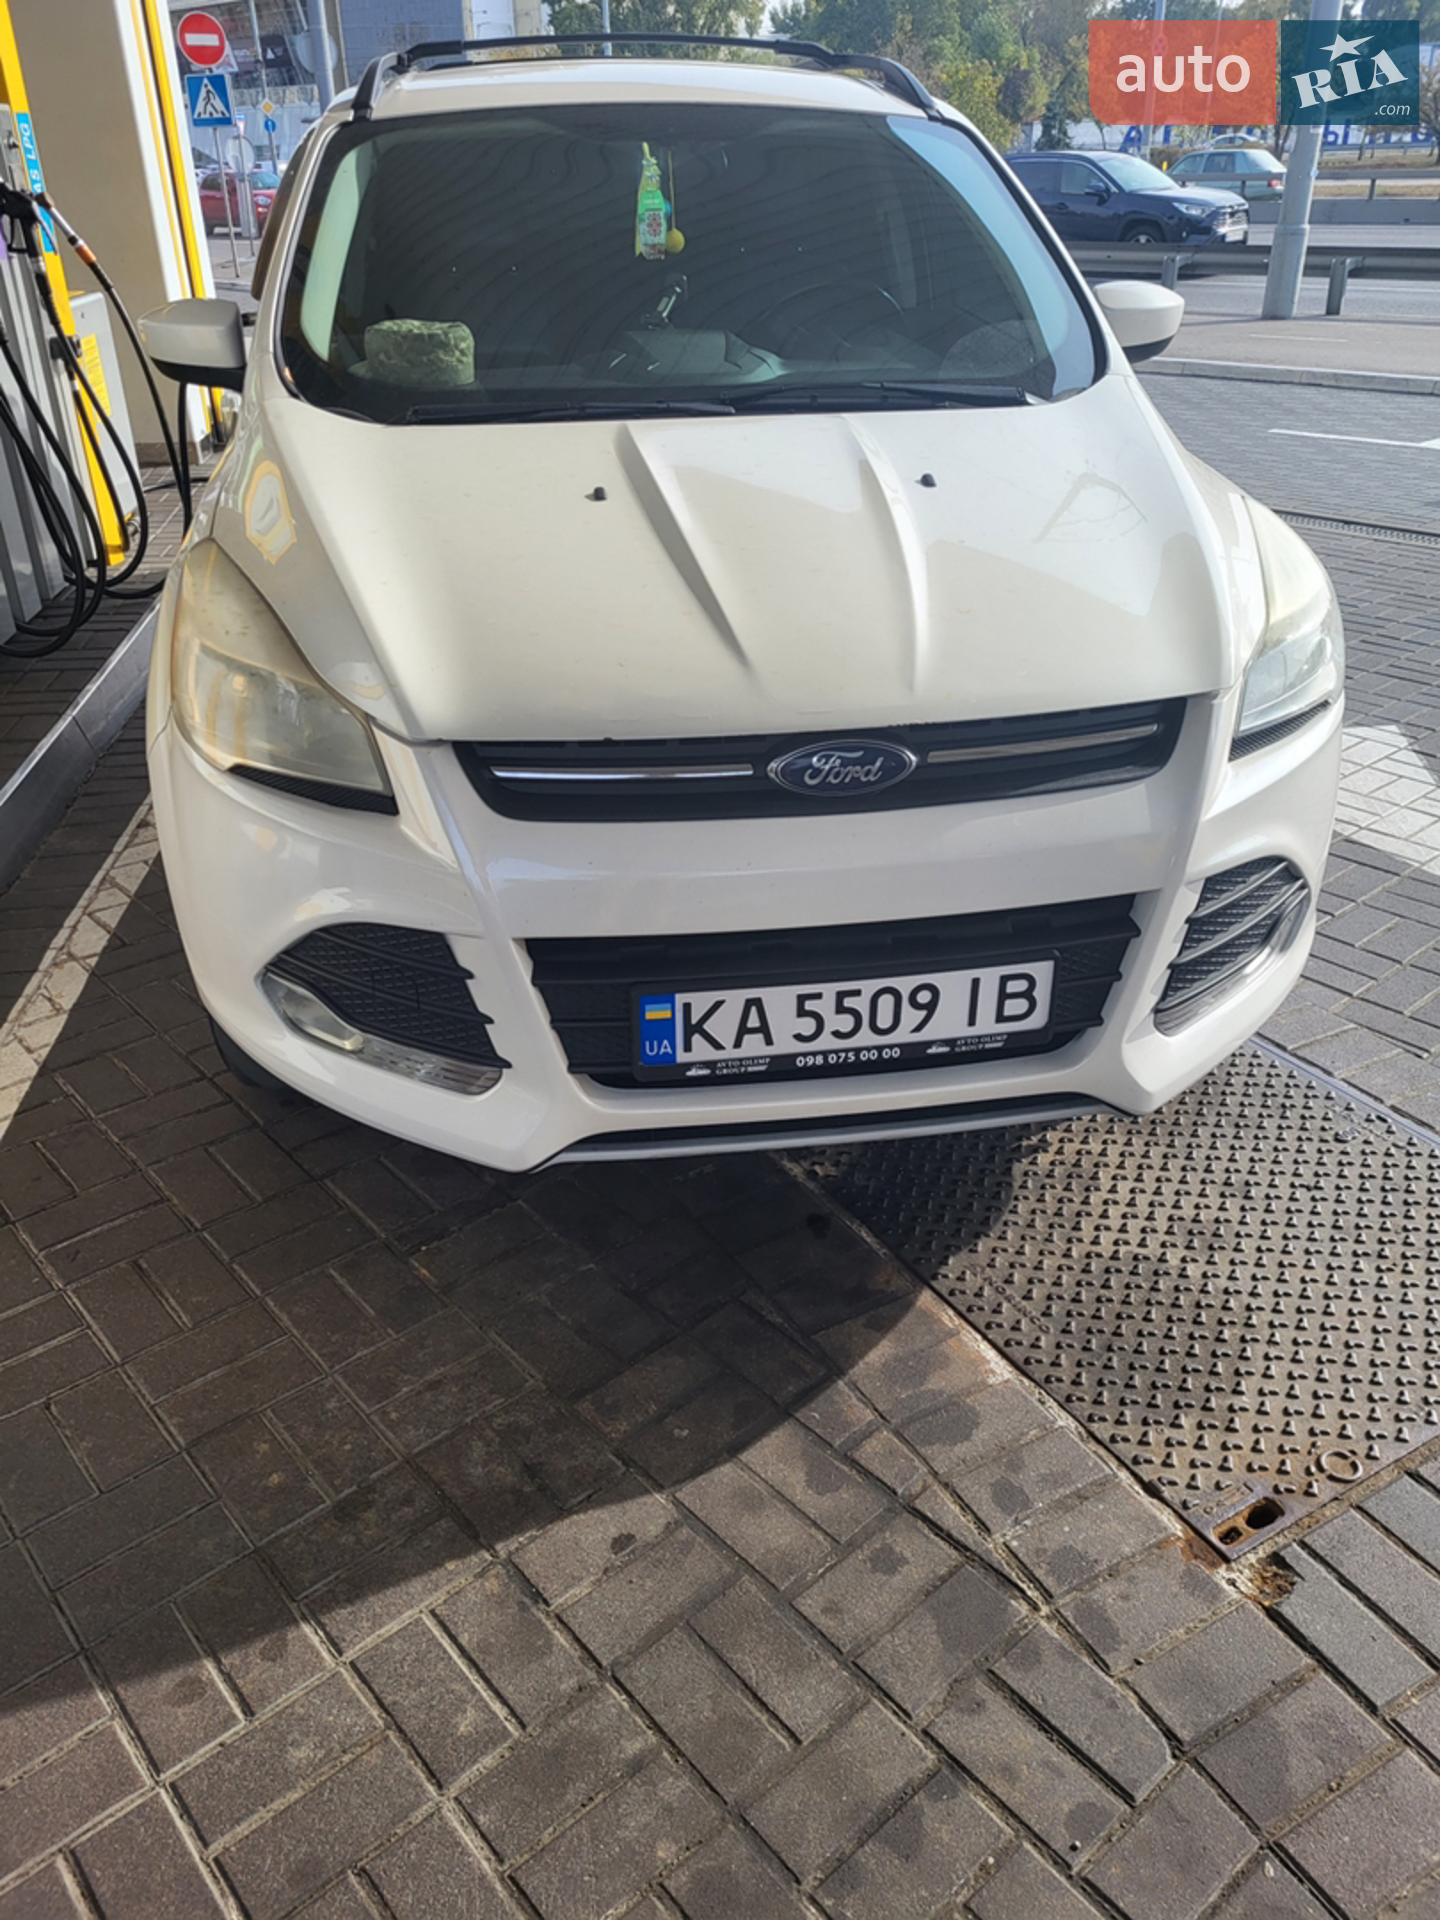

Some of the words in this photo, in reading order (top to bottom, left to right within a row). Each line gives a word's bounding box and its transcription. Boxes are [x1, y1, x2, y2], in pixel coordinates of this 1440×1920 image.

[20, 123, 37, 160] LPG
[803, 750, 885, 786] Ford
[682, 996, 775, 1054] KA
[791, 983, 941, 1044] 5509
[967, 972, 1038, 1028] IB
[645, 1039, 673, 1056] UA
[795, 1054, 824, 1067] 098
[828, 1051, 855, 1064] 075
[859, 1049, 878, 1060] 00
[882, 1046, 900, 1058] 00
